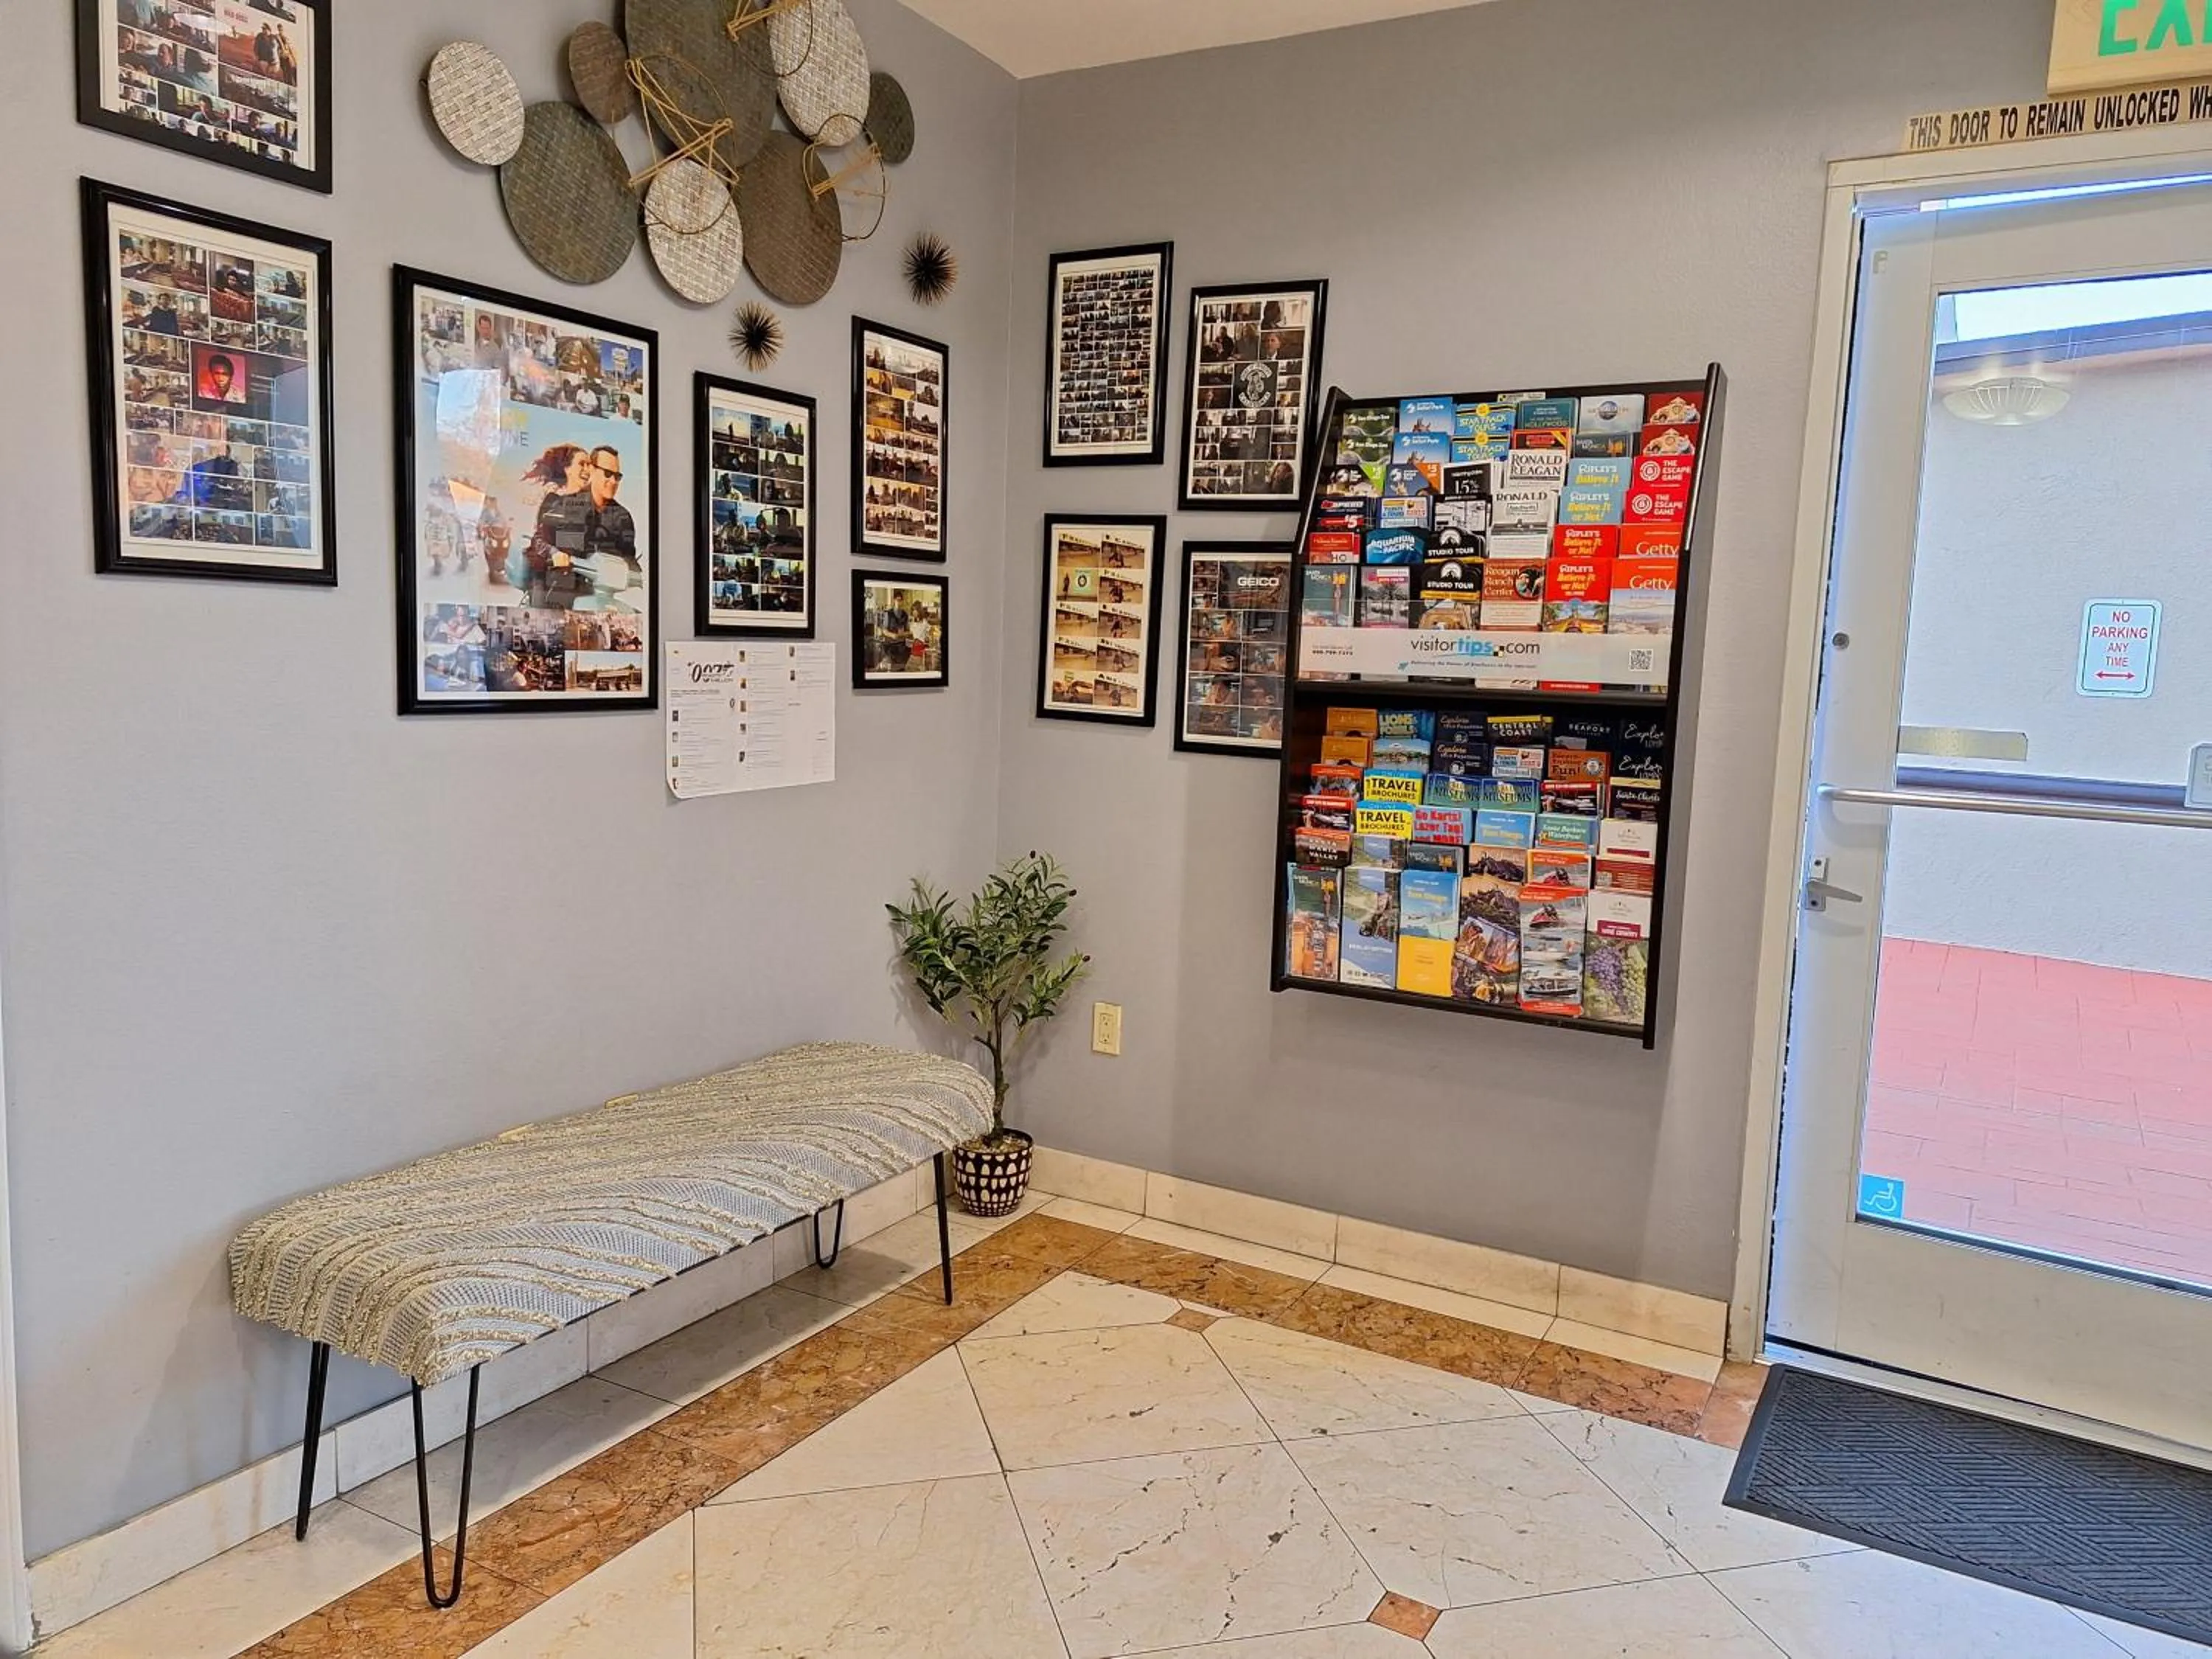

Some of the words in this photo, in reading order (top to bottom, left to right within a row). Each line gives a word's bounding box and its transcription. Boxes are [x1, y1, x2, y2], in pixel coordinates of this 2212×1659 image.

[1909, 115, 1941, 149] THIS
[1950, 111, 1990, 145] DOOR
[1999, 107, 2018, 139] TO
[2026, 100, 2086, 136] REMAIN
[2094, 88, 2180, 130] UNLOCKED
[1512, 453, 1562, 465] RONALD
[1511, 466, 1562, 478] REAGAN
[1495, 491, 1548, 502] RONALD
[1653, 501, 1683, 509] ESCAPE
[1428, 549, 1453, 557] STUDIO
[1455, 546, 1474, 555] TOUR
[1635, 540, 1680, 555] Getty
[1485, 566, 1520, 579] Reagan
[1237, 577, 1280, 587] GEICO
[1427, 581, 1453, 589] STUDIO
[1454, 582, 1474, 590] TOUR
[1484, 576, 1514, 586] Ranch
[1629, 574, 1674, 591] Getty
[1484, 587, 1514, 597] Center
[2112, 611, 2131, 623] NO
[2092, 627, 2149, 639] PARKING
[2107, 642, 2130, 653] ANY
[2106, 655, 2129, 667] TIME
[1492, 722, 1537, 731] CENTRAL
[1569, 724, 1611, 733] SEAPORT
[1371, 778, 1417, 792] TRAVEL
[1371, 790, 1416, 800] BROCHURES
[1360, 811, 1405, 824] TRAVEL
[1360, 822, 1405, 831] BROCHURES
[1309, 852, 1338, 860] VALLEY
